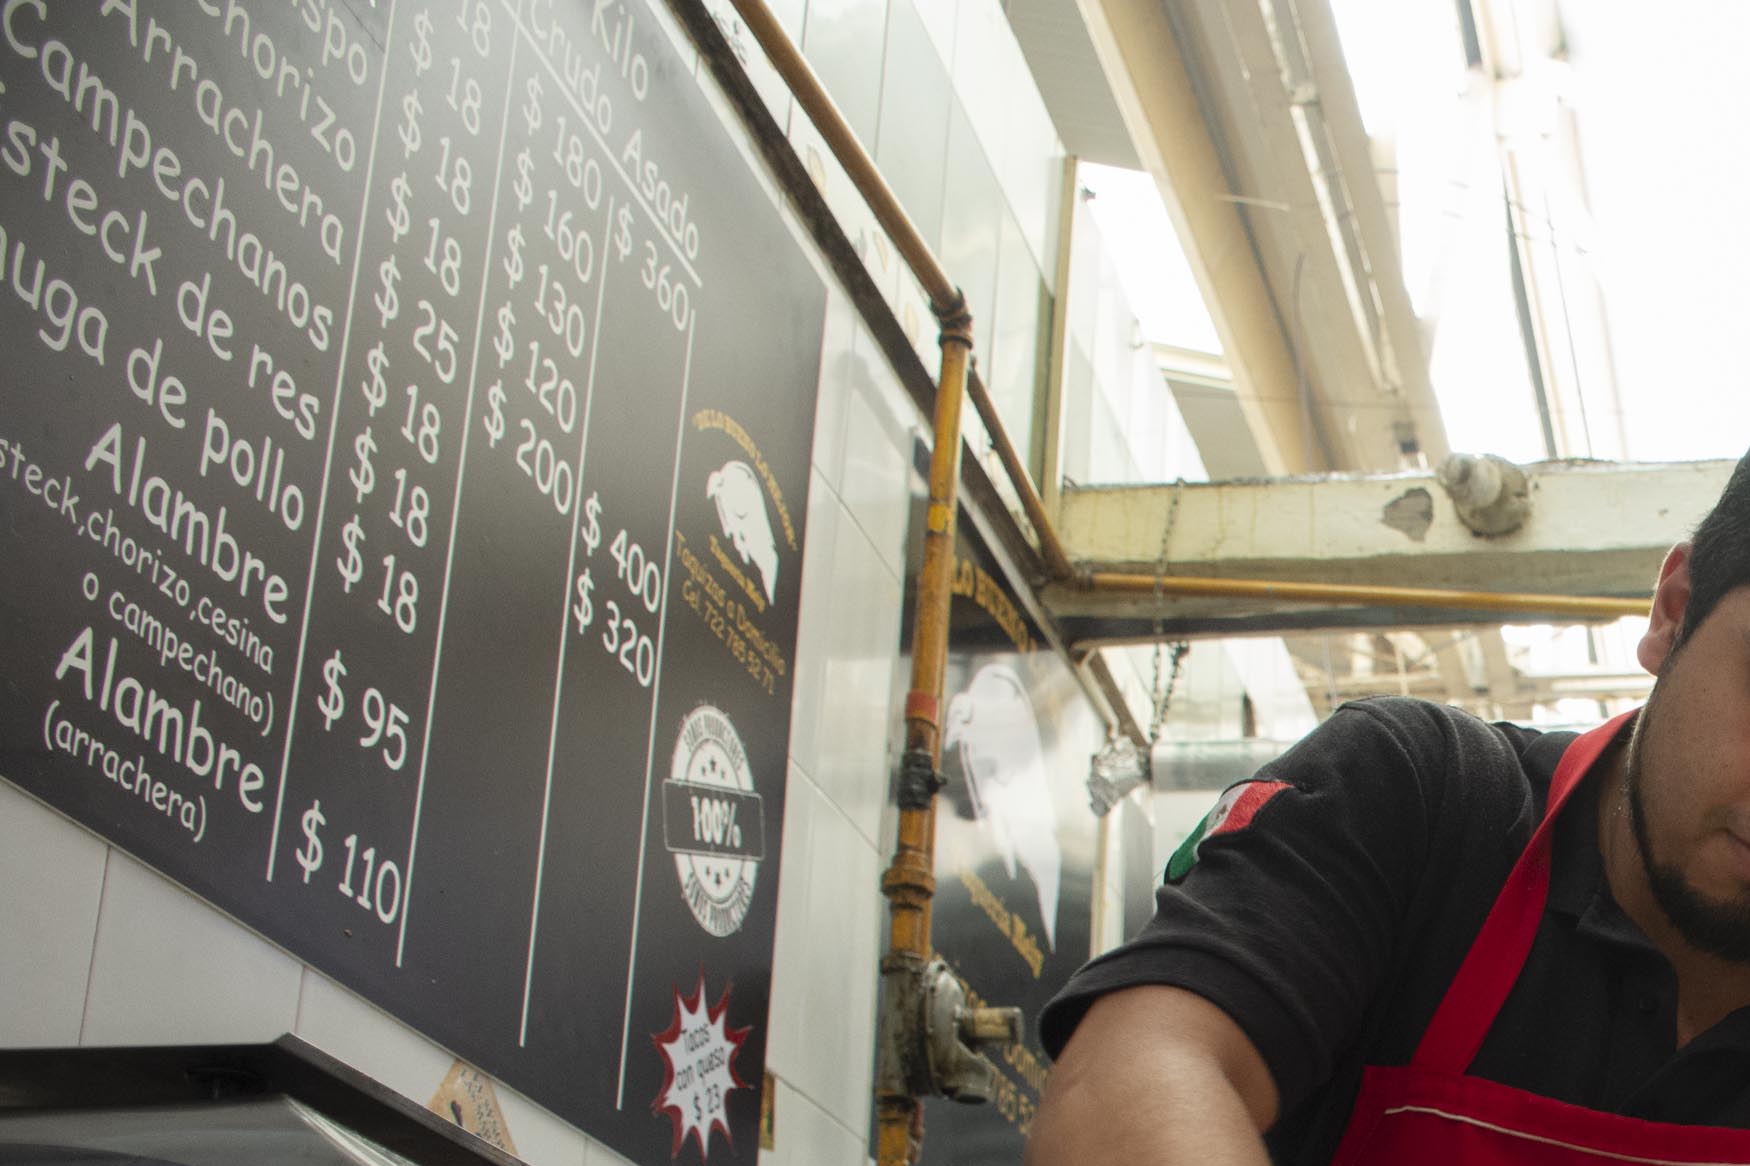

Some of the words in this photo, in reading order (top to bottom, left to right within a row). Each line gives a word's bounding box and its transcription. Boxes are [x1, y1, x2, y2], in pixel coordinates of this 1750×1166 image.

[101, 0, 343, 264] Arrachera
[201, 0, 355, 172] horizo
[411, 10, 433, 75] $
[447, 58, 482, 135] 18
[3, 0, 332, 351] Campechanos
[400, 90, 421, 158] $
[437, 137, 472, 215] 18
[523, 73, 543, 135] $
[554, 117, 601, 210] 180
[623, 129, 699, 261] Asado
[0, 82, 161, 296] steck
[177, 272, 232, 361] de
[249, 344, 319, 440] res
[387, 173, 412, 242] $
[425, 219, 461, 296] 18
[514, 148, 534, 211] $
[544, 191, 592, 282] 160
[615, 208, 633, 261] $
[642, 241, 688, 331] 360
[375, 255, 401, 327] $
[414, 300, 457, 383] 25
[504, 224, 525, 288] $
[535, 266, 584, 357] 130
[0, 222, 108, 366] uga
[127, 338, 186, 428] de
[200, 408, 304, 530] pollo
[363, 342, 389, 415] $
[402, 385, 440, 463] 18
[494, 302, 515, 367] $
[526, 342, 576, 432] 120
[351, 427, 378, 503] $
[390, 470, 429, 547] 18
[485, 380, 505, 447] $
[517, 419, 572, 514] 200
[85, 422, 289, 624] Alambre
[337, 515, 365, 593] $
[379, 555, 418, 634] 18
[583, 492, 601, 555] $
[611, 530, 660, 613] 400
[84, 572, 98, 600] o
[109, 590, 274, 736] campechano)
[575, 569, 593, 634] $
[603, 602, 653, 687] 320
[43, 700, 206, 842] (arrachera)
[55, 626, 265, 813] Alambre
[318, 651, 346, 731] $
[360, 688, 409, 770] 95
[296, 801, 325, 884] $
[339, 835, 400, 923] 110
[691, 796, 741, 848] 100%
[677, 1066, 693, 1091] con
[697, 1046, 726, 1085] queso
[681, 1024, 711, 1054] Tacos
[694, 1093, 702, 1121] $
[706, 1083, 721, 1114] 23
